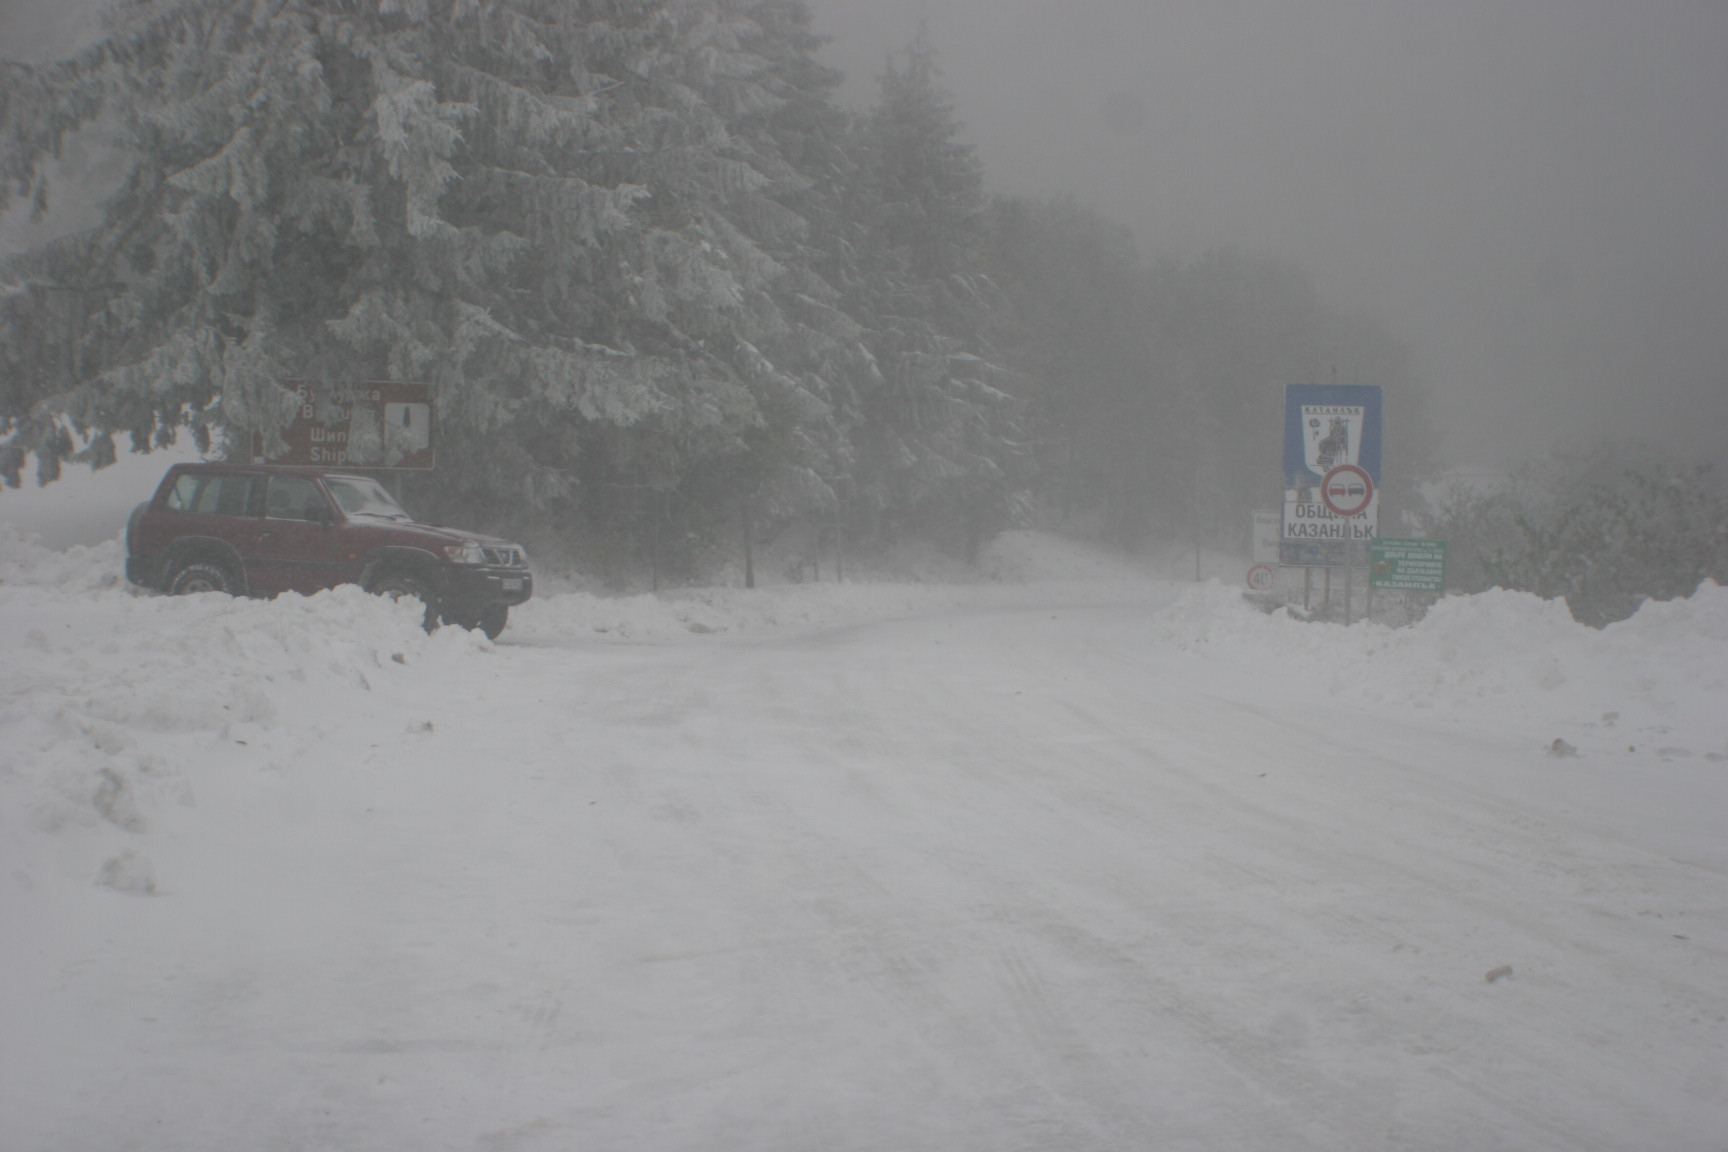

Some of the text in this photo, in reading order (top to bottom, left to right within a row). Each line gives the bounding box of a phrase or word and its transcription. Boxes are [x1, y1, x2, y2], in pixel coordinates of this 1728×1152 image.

[311, 427, 347, 442] Шип
[311, 446, 348, 465] Ship
[1295, 504, 1368, 520] ОБЩА
[1287, 523, 1374, 538] КАЗАНЛЪК
